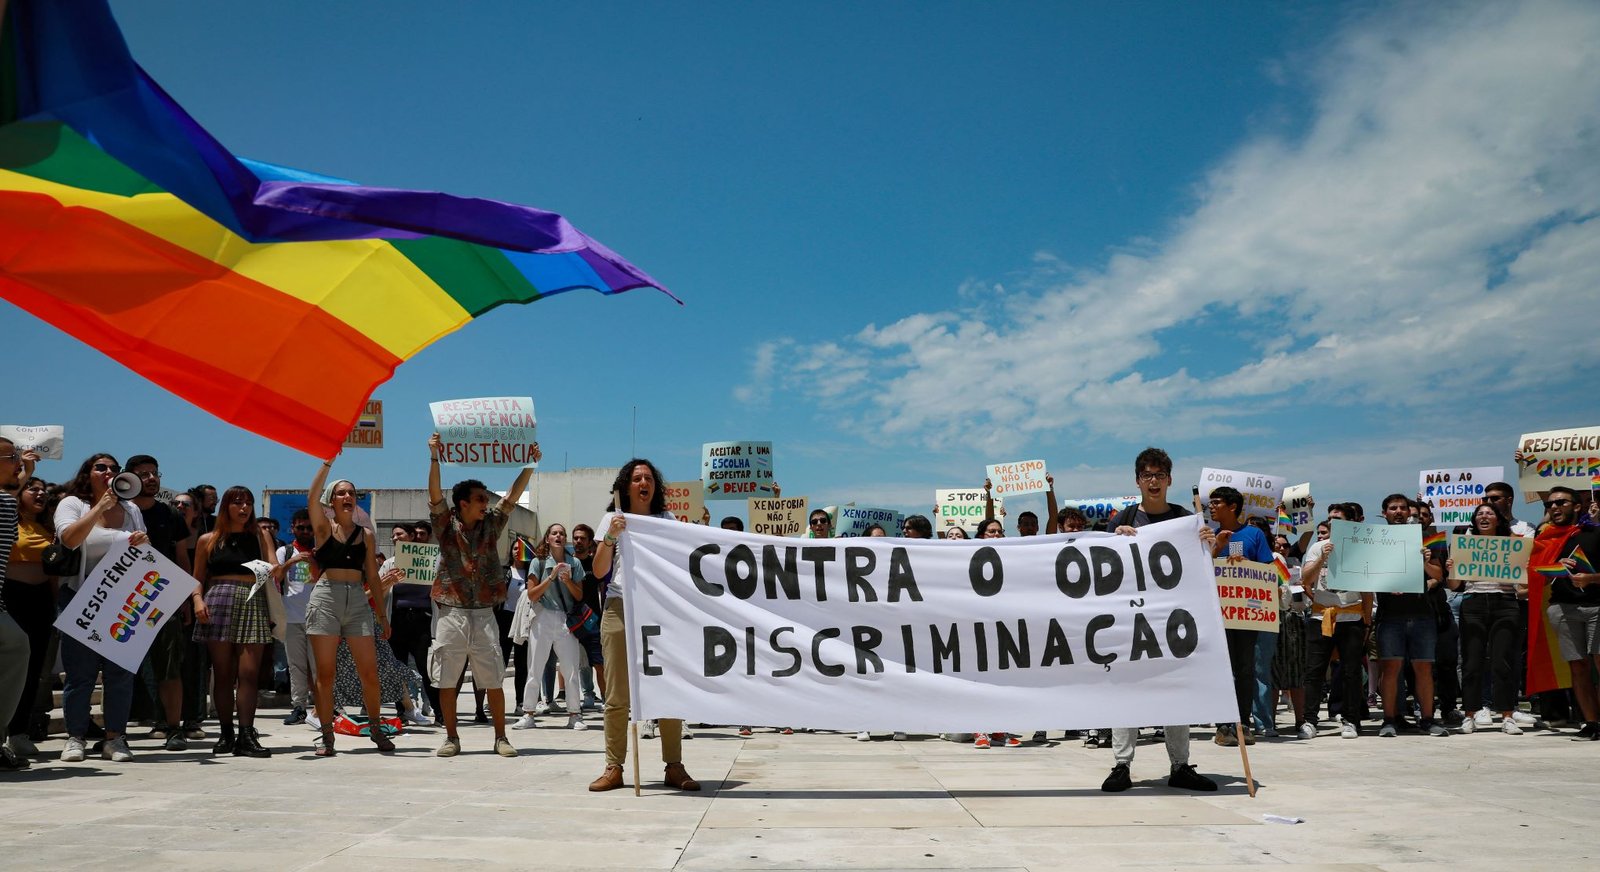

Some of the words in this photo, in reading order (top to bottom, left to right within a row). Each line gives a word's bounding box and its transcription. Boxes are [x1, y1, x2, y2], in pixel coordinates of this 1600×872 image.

[443, 399, 522, 411] RESPEITA
[437, 411, 535, 428] EXISTÊNCIA
[449, 427, 467, 439] OU
[474, 427, 526, 441] ESPERA
[16, 444, 49, 453] ACISMO
[1523, 433, 1600, 453] RESISTÊNCI
[438, 440, 537, 463] RESISTÊNCIA
[709, 446, 741, 457] ACEITAR
[757, 446, 770, 455] UMA
[713, 458, 751, 469] ESCOLHA
[994, 461, 1043, 475] RACISMO
[709, 470, 752, 480] RESPEITAR
[1207, 471, 1233, 484] ÓDIO
[1426, 471, 1450, 483] NÃO
[1458, 472, 1472, 482] AO
[723, 481, 757, 494] DEVER
[1426, 483, 1484, 496] RACISMO
[947, 493, 978, 501] STOP
[1439, 498, 1482, 508] DISCRIMIN
[754, 499, 804, 511] XENOFOBIA
[767, 511, 783, 521] NÃO
[843, 508, 893, 522] XENOFOBIA
[1441, 511, 1473, 523] IMPUN
[755, 520, 799, 535] OPINIÃO
[1457, 536, 1523, 552] RACISMO
[412, 556, 430, 568] NÃO
[1472, 549, 1498, 563] NÃO
[1503, 550, 1511, 563] É
[689, 543, 924, 603] CONTRA
[968, 546, 1004, 597] O
[1055, 538, 1183, 599] ÓDIO
[1457, 563, 1522, 580] OPINIÃO
[76, 544, 143, 630] RESISTÊNCIA
[1217, 585, 1273, 602] IBERDADE
[110, 570, 170, 643] QUEER
[1221, 605, 1277, 622] XPRESSÃO
[640, 625, 663, 676] E
[703, 598, 1199, 678] DISCRIMINAÇÃO
